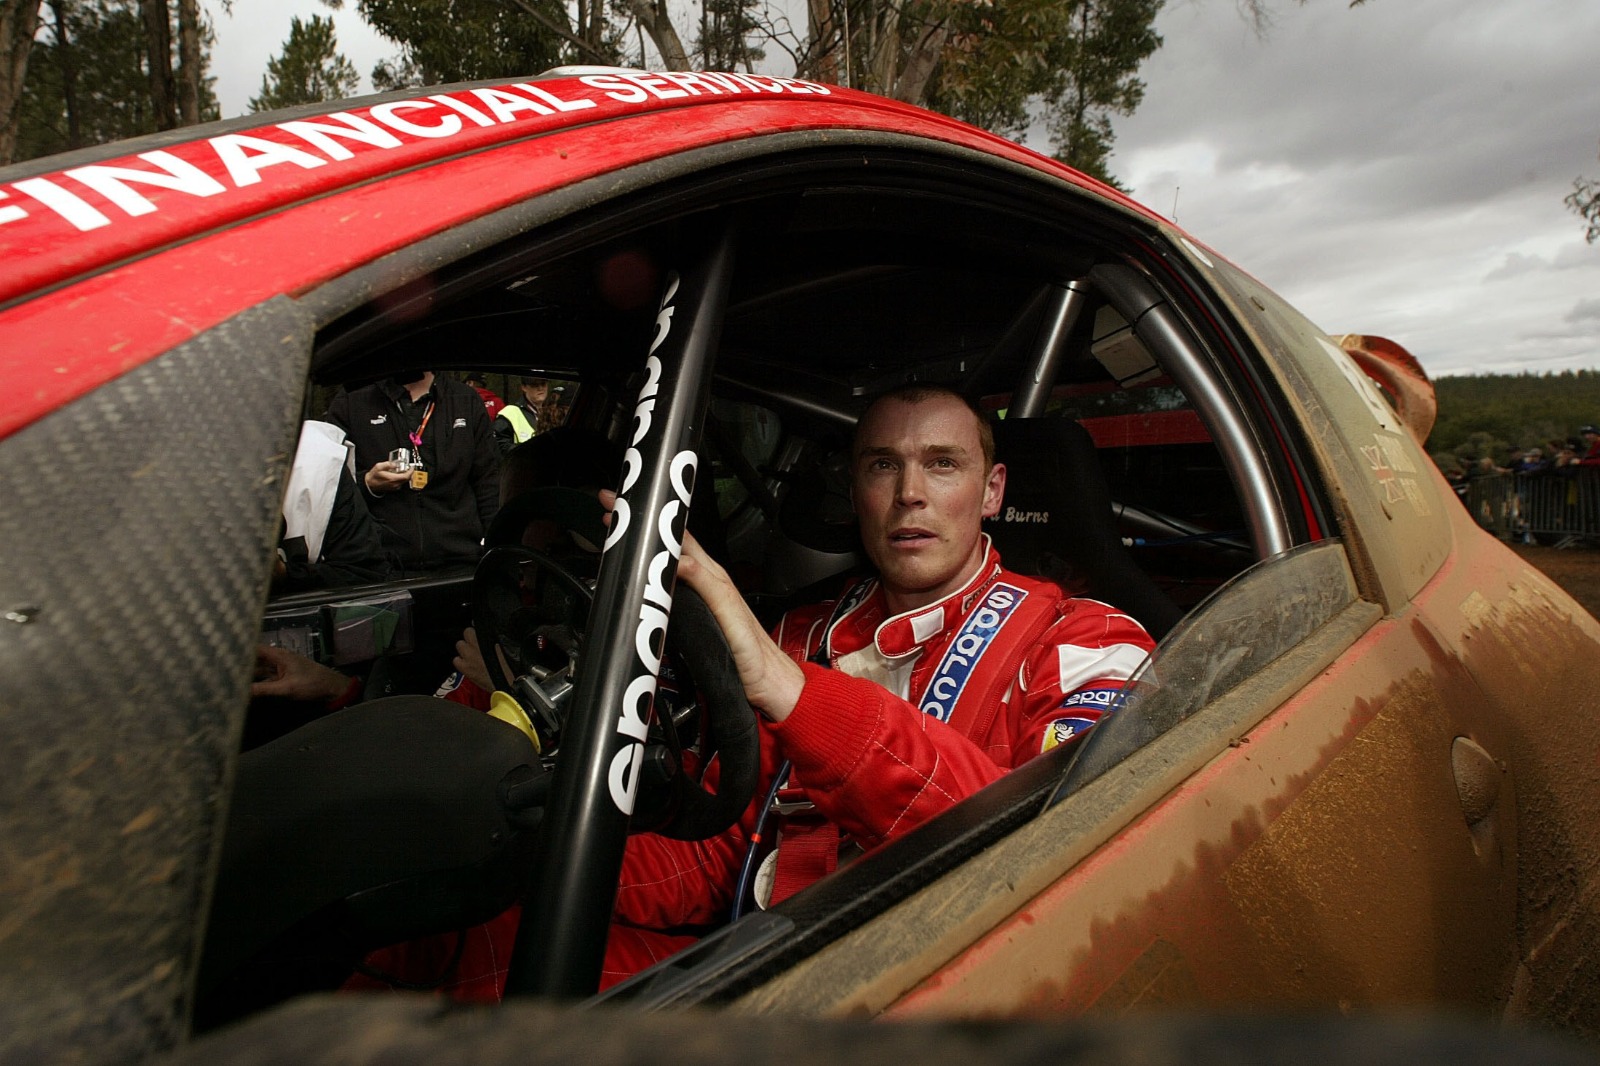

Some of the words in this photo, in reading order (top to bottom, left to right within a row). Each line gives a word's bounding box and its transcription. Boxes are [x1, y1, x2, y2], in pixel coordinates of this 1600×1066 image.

[580, 71, 831, 103] SERVICES
[1004, 506, 1049, 523] Burns
[922, 591, 1014, 720] sparco
